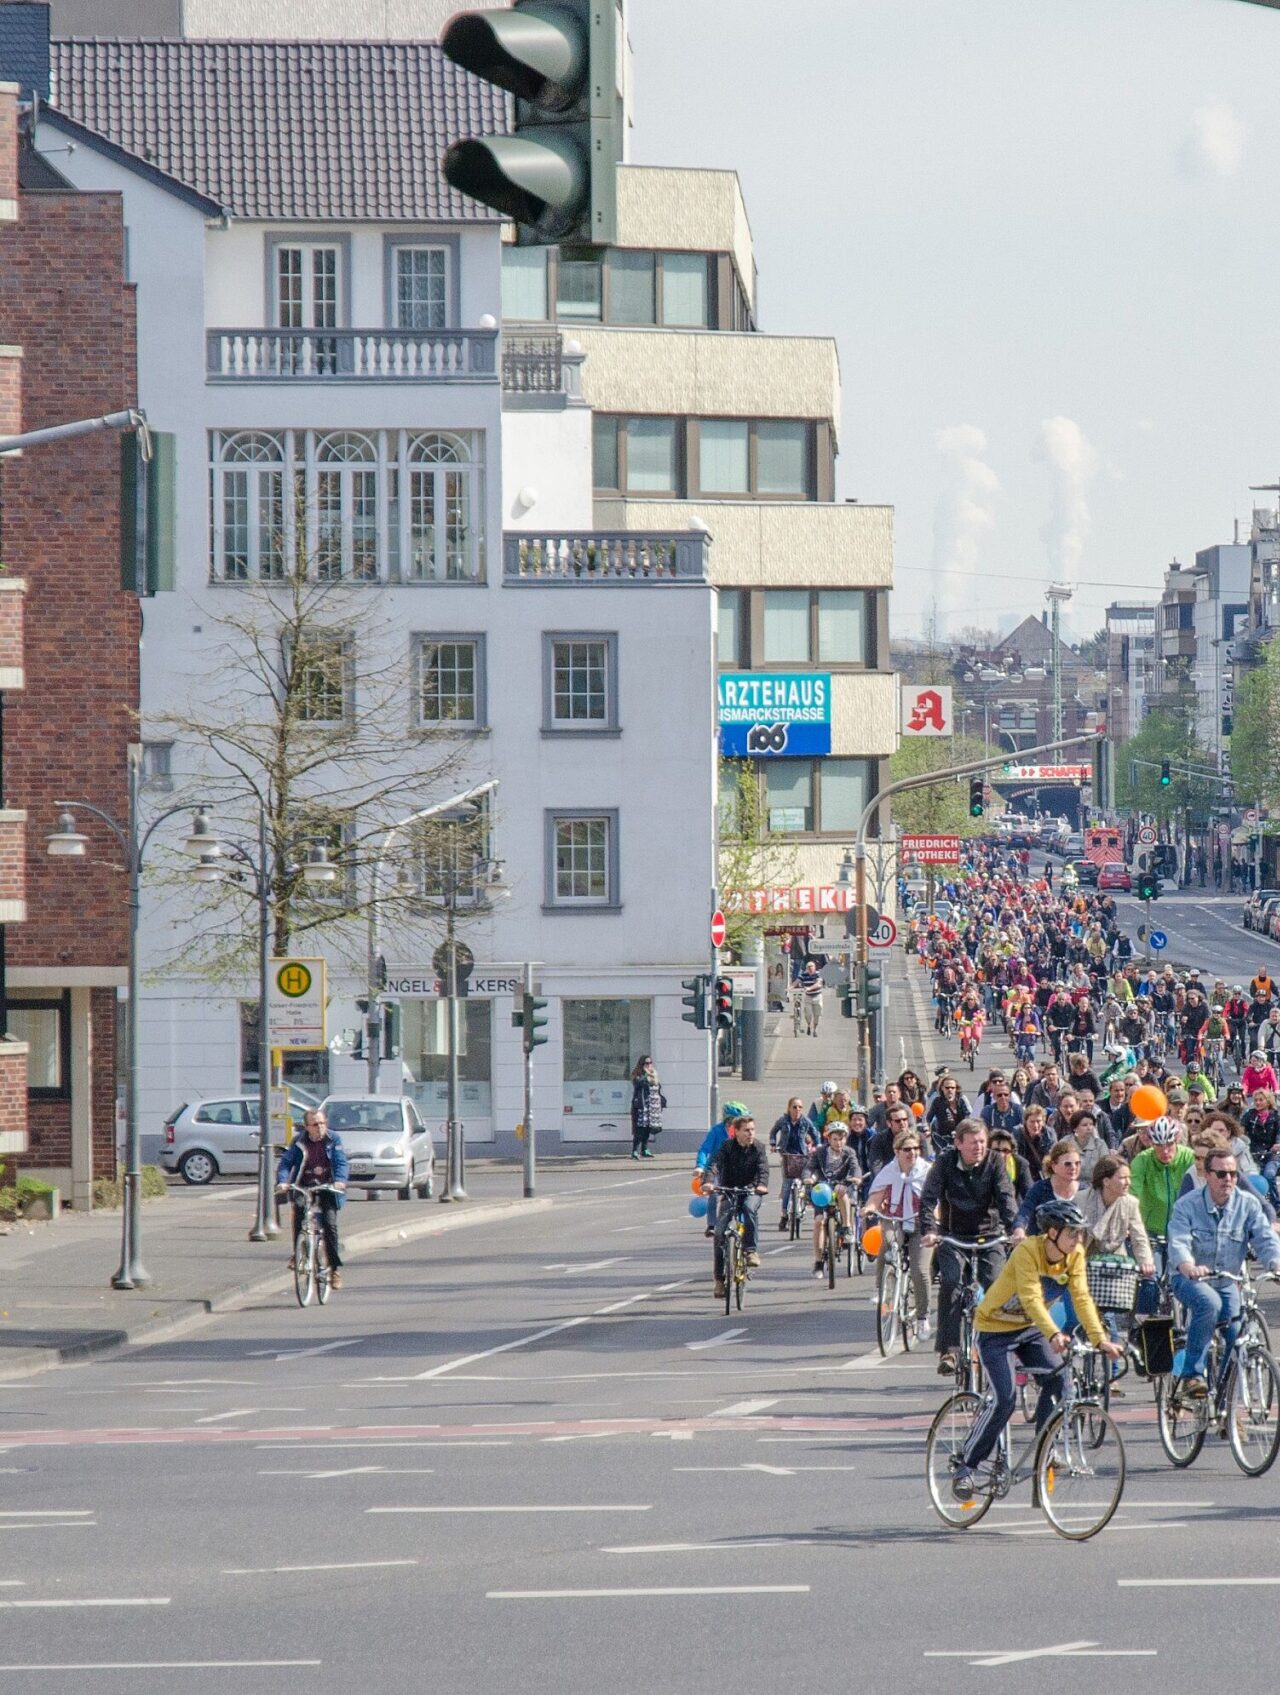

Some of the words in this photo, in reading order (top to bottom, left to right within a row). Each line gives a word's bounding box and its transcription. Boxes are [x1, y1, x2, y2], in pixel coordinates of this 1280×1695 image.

[718, 707, 825, 721] ISMARCKSTRASSE
[902, 839, 958, 849] FRIEDRICH
[902, 850, 958, 860] AOTHEKE
[726, 890, 858, 911] OTHEKE
[287, 970, 302, 990] H
